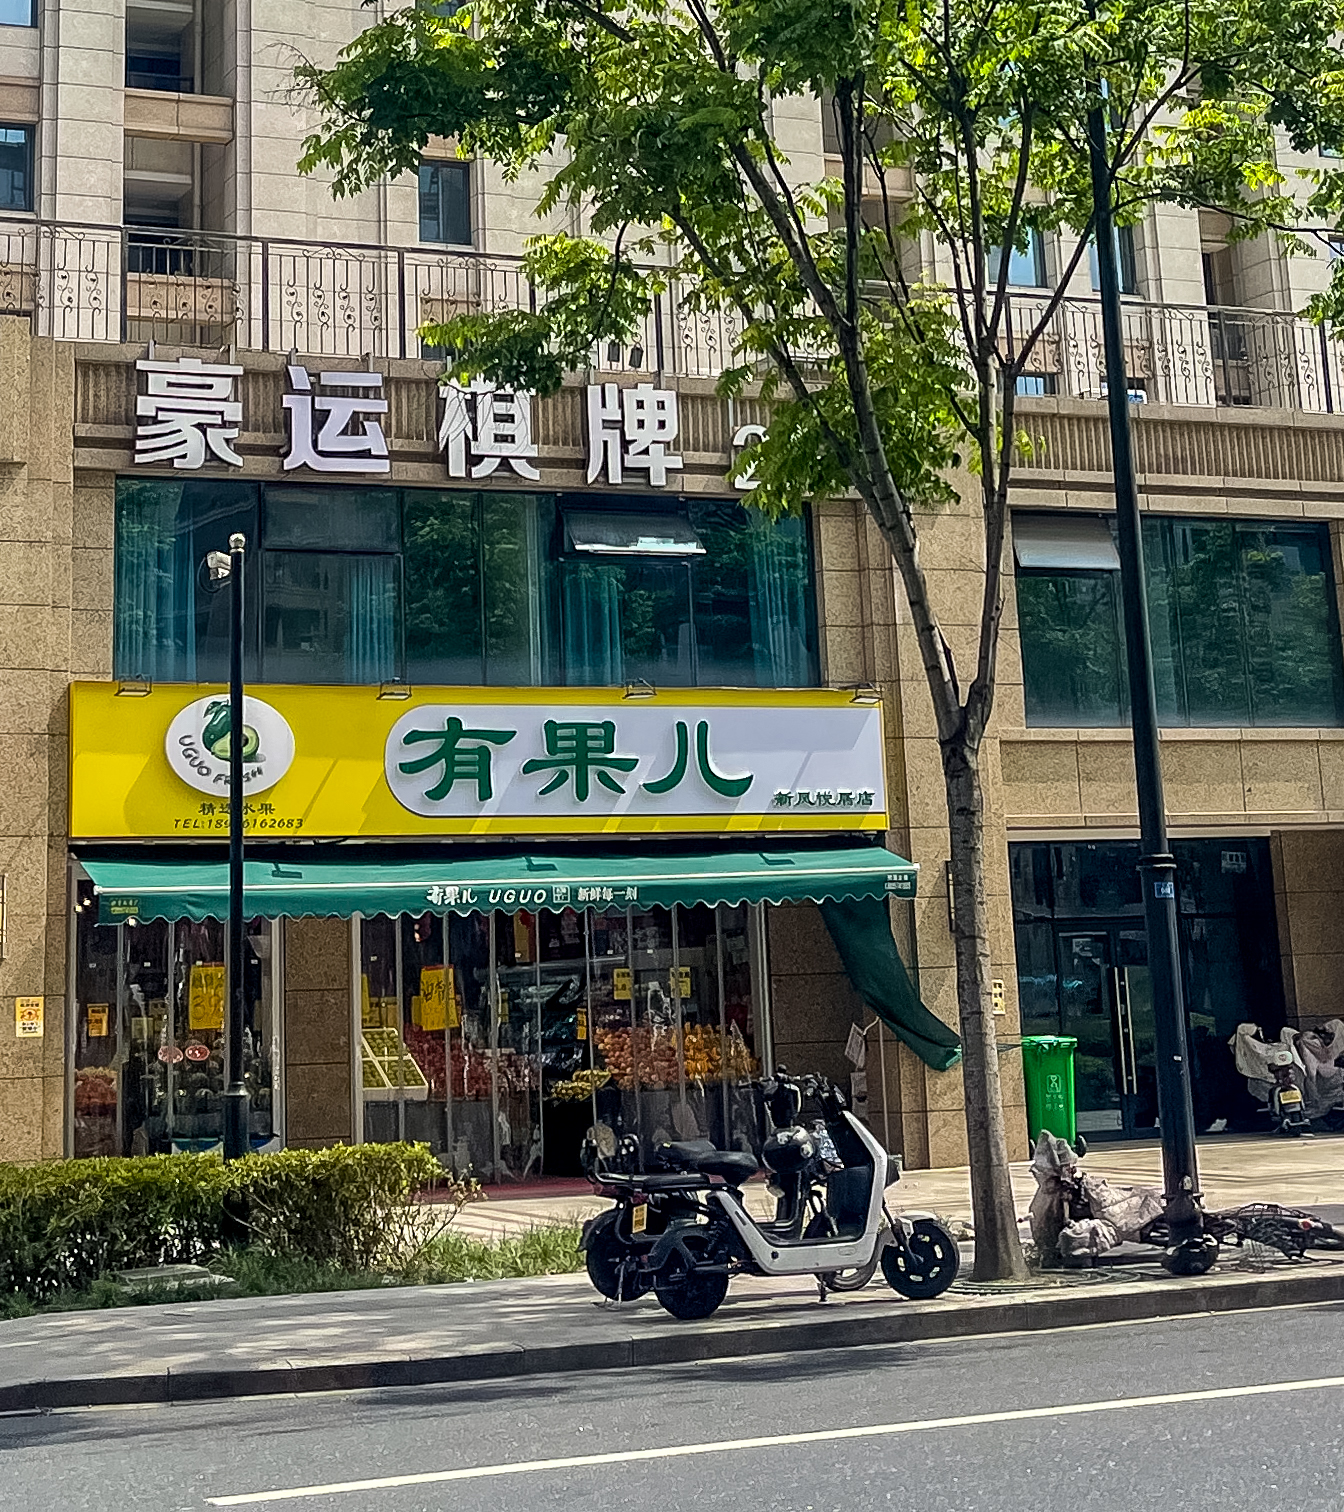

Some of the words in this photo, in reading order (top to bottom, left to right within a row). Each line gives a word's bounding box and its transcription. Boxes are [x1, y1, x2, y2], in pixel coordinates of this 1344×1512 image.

[178, 734, 212, 777] UGUO
[213, 766, 263, 786] FRSH
[399, 716, 754, 803] 有果儿
[489, 888, 547, 904] UGUO
